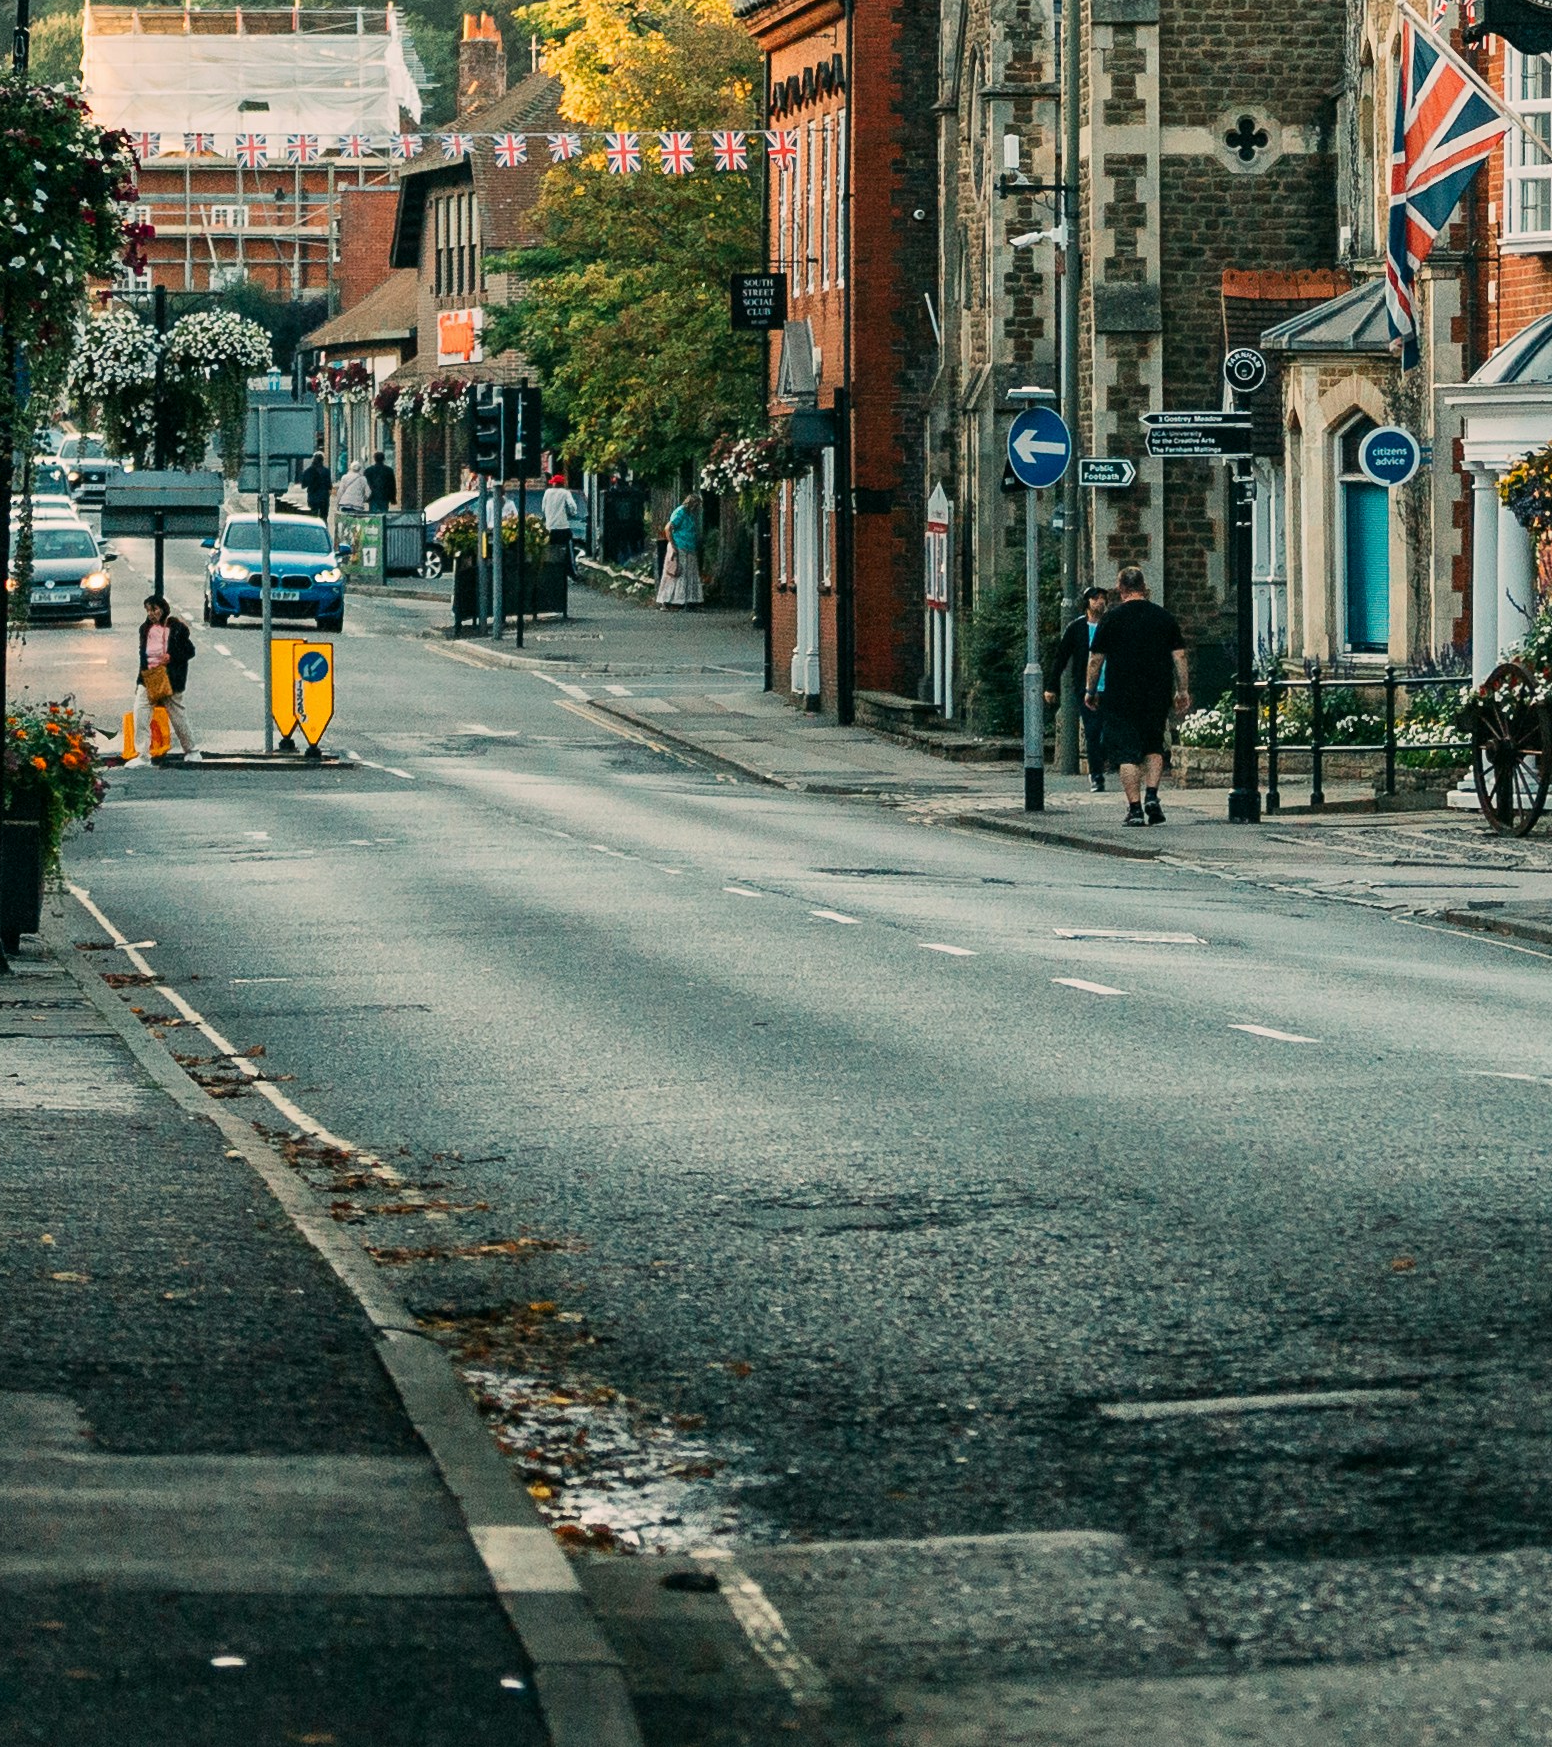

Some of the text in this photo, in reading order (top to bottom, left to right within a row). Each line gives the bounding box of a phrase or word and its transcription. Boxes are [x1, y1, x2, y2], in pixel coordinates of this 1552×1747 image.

[743, 279, 774, 287] SOUTH
[742, 288, 775, 297] STREET
[742, 298, 774, 306] SOCIAL
[746, 307, 771, 316] CLUB
[1372, 447, 1407, 456] citizens
[1375, 457, 1405, 466] advice
[1089, 464, 1114, 472] Public
[1084, 472, 1119, 481] Footpath
